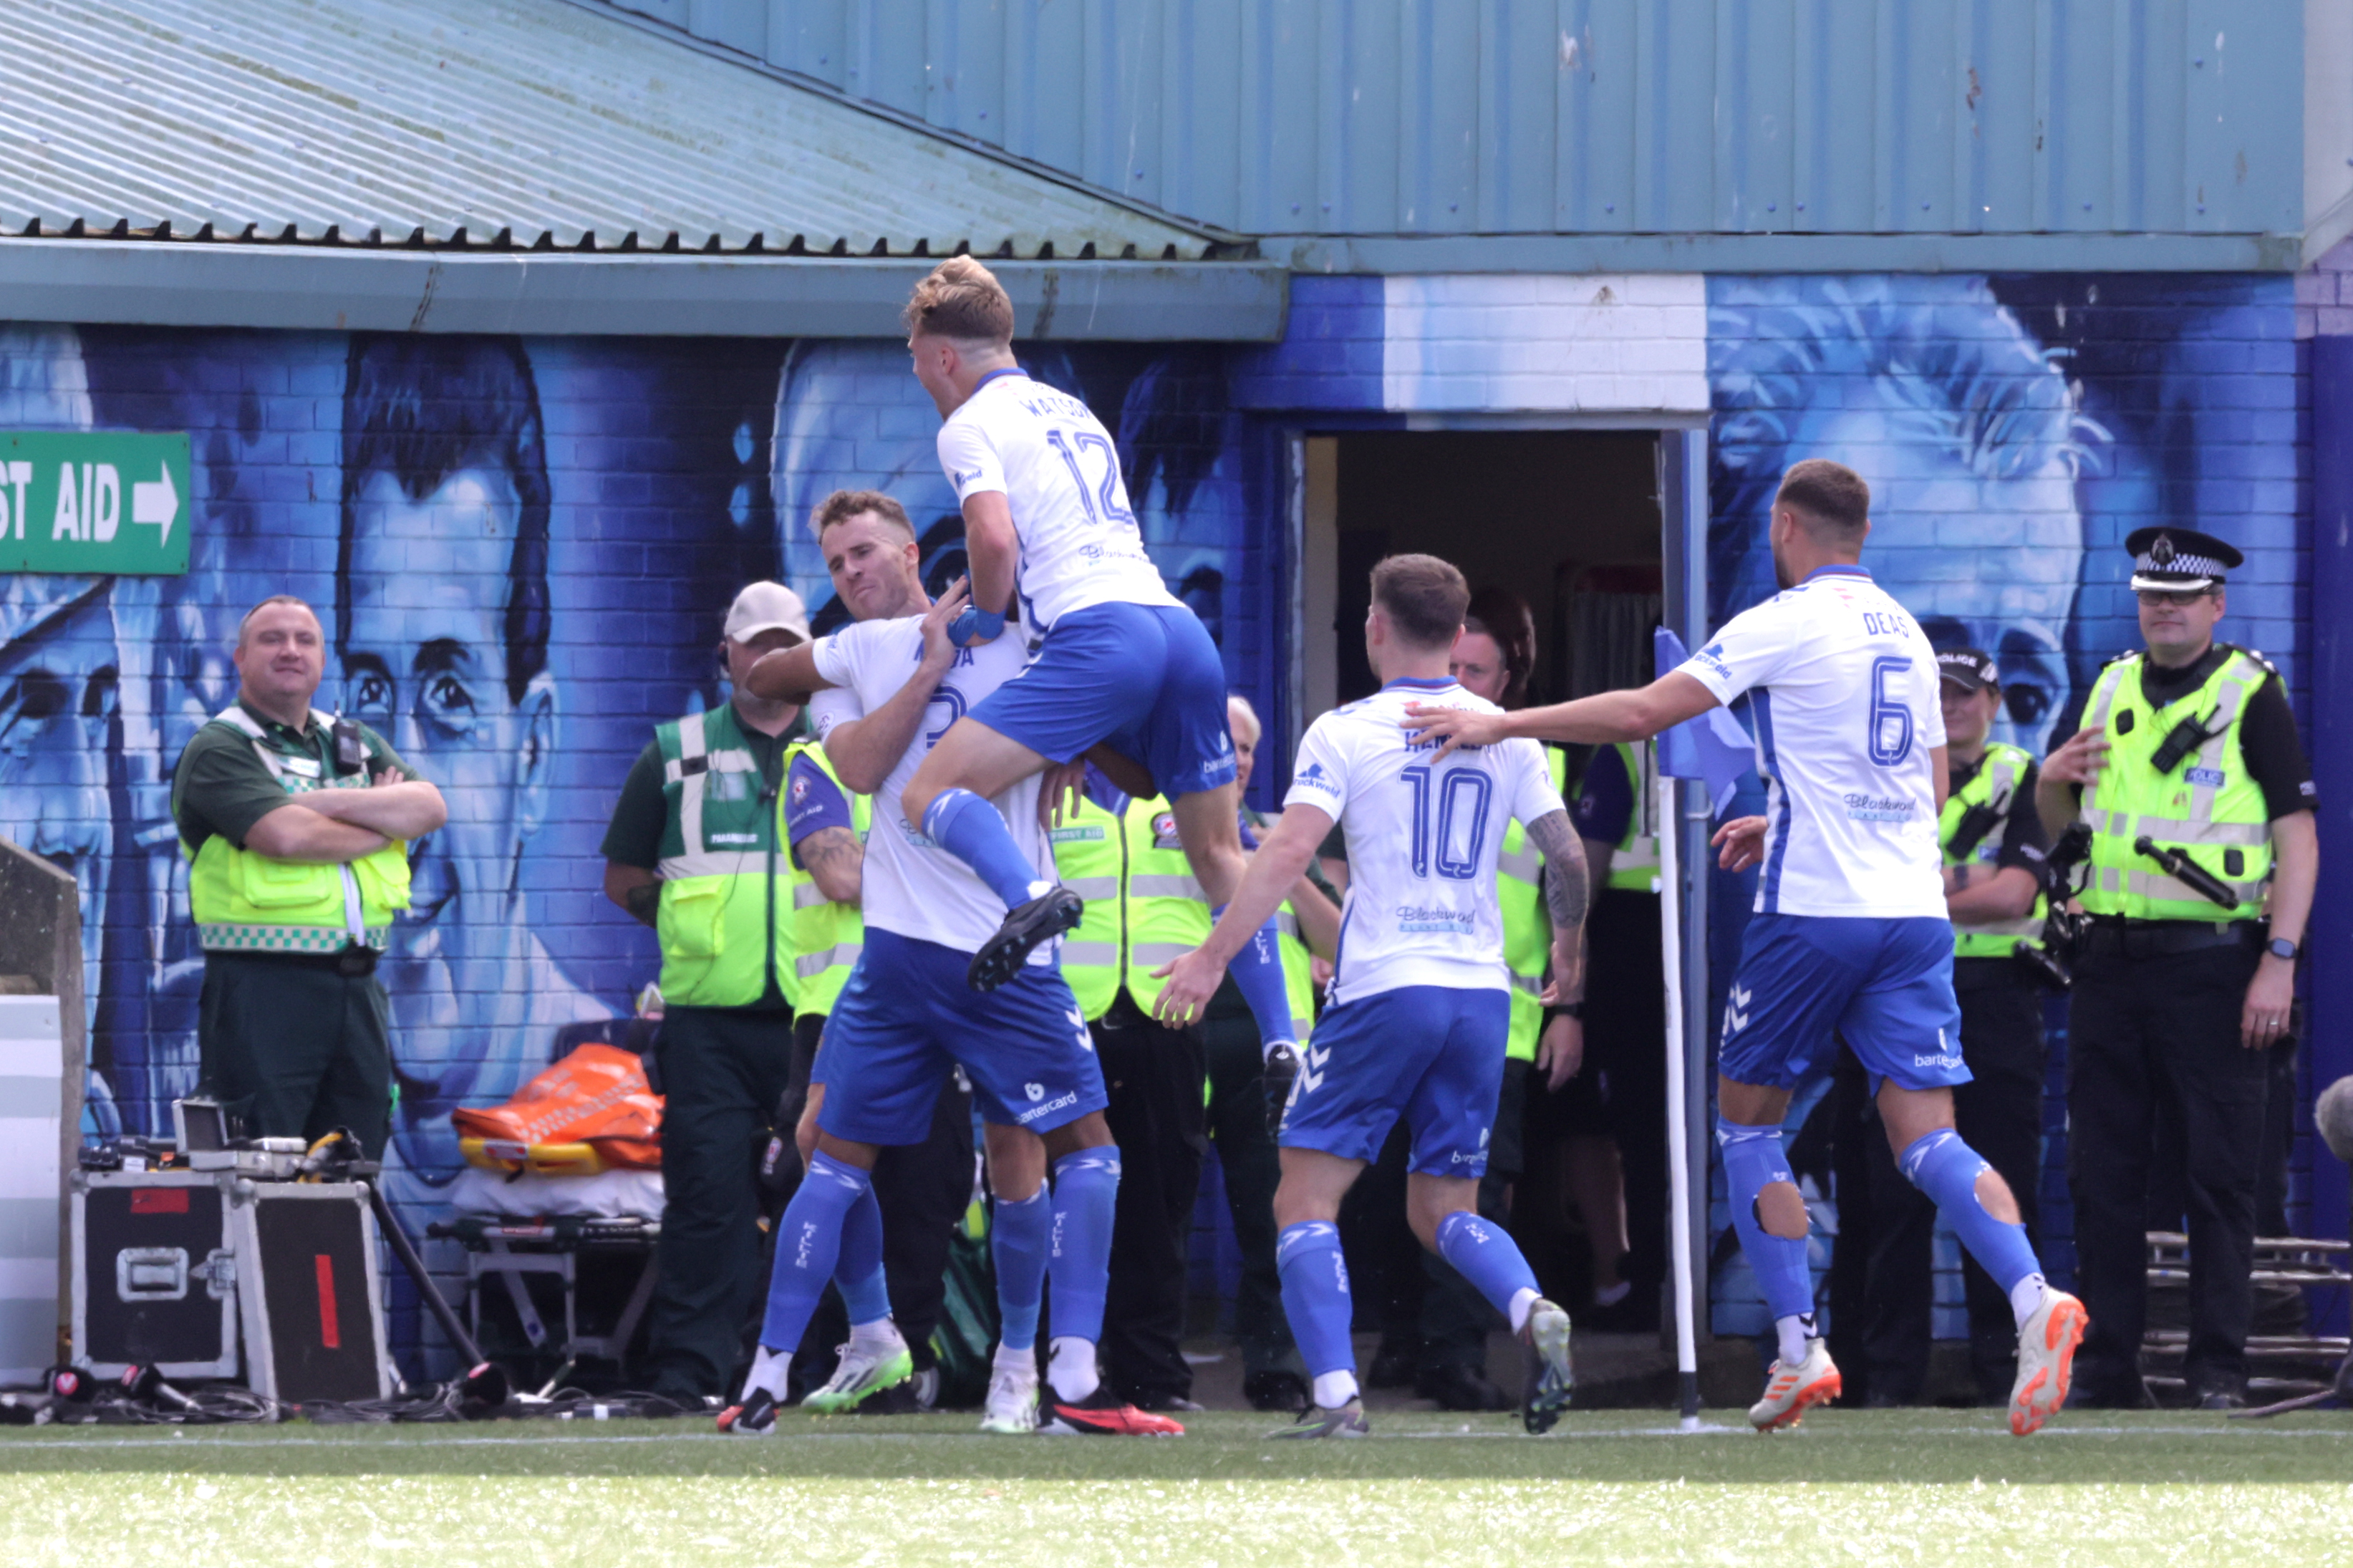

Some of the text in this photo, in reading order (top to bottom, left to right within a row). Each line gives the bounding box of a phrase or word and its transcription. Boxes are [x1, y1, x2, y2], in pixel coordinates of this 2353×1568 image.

[52, 462, 120, 542] AID
[1045, 429, 1134, 526] 12
[1862, 612, 1910, 639] DEAS
[1868, 655, 1913, 767] 6
[1400, 765, 1493, 880] 10
